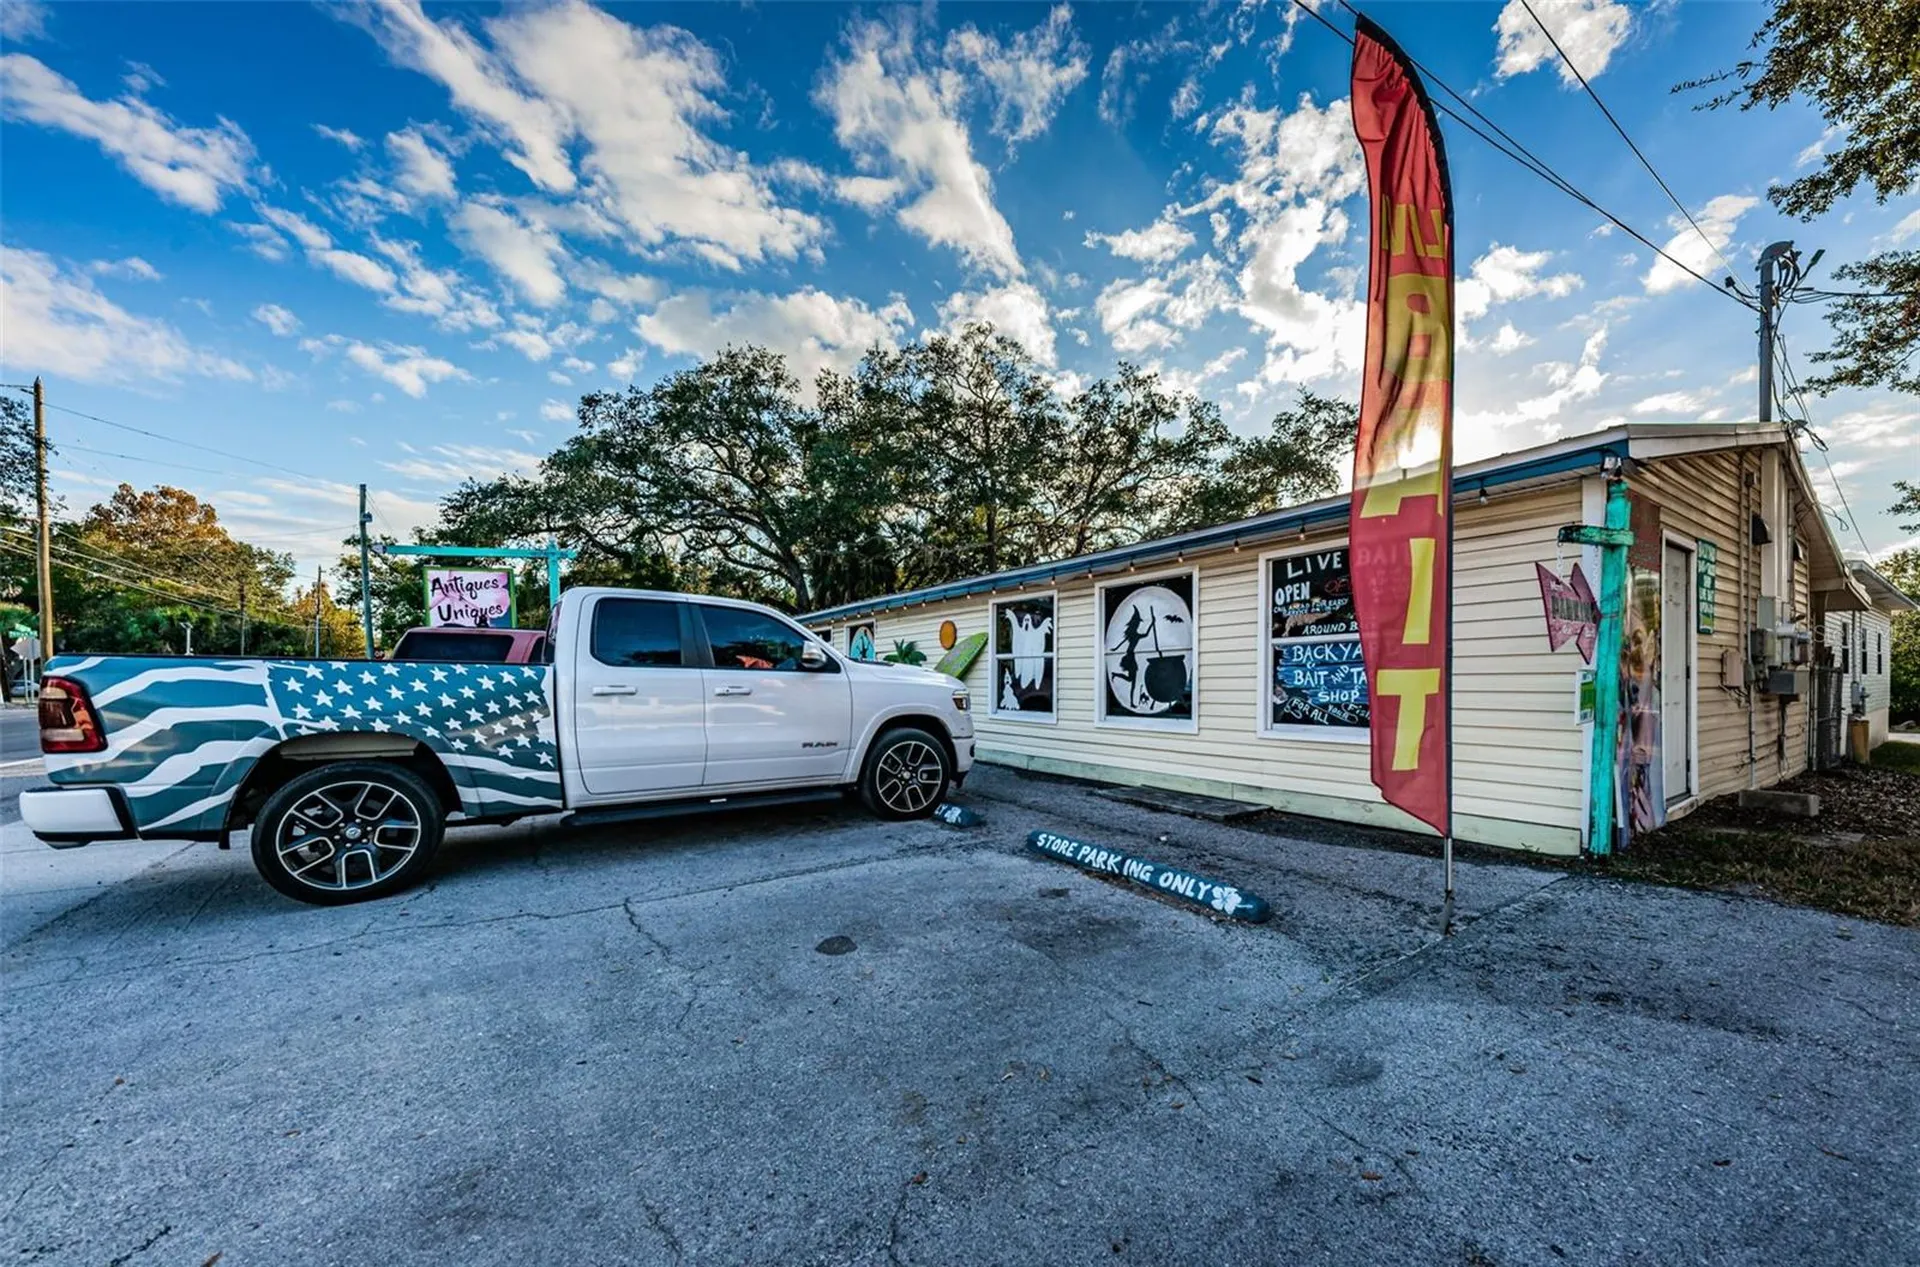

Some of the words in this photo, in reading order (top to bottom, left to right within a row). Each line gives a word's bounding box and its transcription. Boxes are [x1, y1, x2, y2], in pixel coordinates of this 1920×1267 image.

[1286, 551, 1342, 579] LIVE
[431, 576, 499, 600] Antiques
[1275, 581, 1310, 606] OPEN
[438, 604, 503, 627] Uniques
[1302, 622, 1347, 635] AROUND
[1293, 669, 1329, 688] BAIT
[1330, 665, 1349, 685] AND
[1317, 689, 1360, 703] SHOP
[1291, 698, 1311, 715] FOR
[1310, 708, 1329, 725] ALL
[1036, 833, 1079, 858] STORE
[1159, 871, 1212, 901] ONLY
